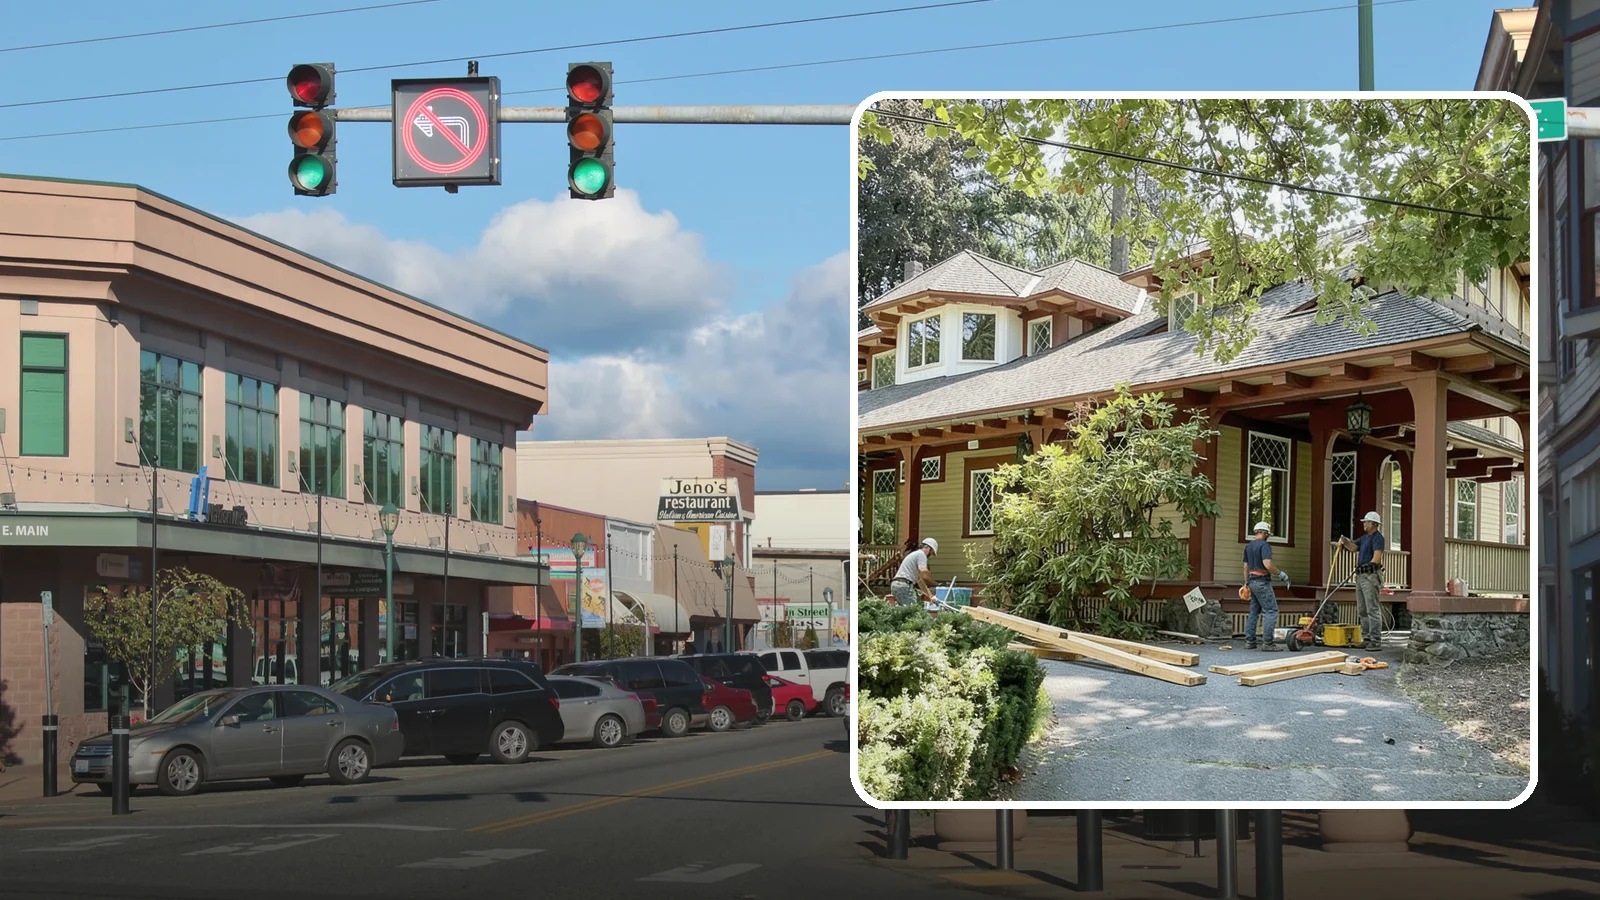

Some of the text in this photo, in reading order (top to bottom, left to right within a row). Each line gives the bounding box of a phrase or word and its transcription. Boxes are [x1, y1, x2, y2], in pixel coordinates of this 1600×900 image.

[669, 480, 727, 494] Jeno's
[665, 497, 731, 509] restaurant
[686, 510, 714, 519] American
[715, 510, 737, 519] Cuisine
[2, 525, 49, 536] E. MAIN
[797, 607, 829, 617] Street
